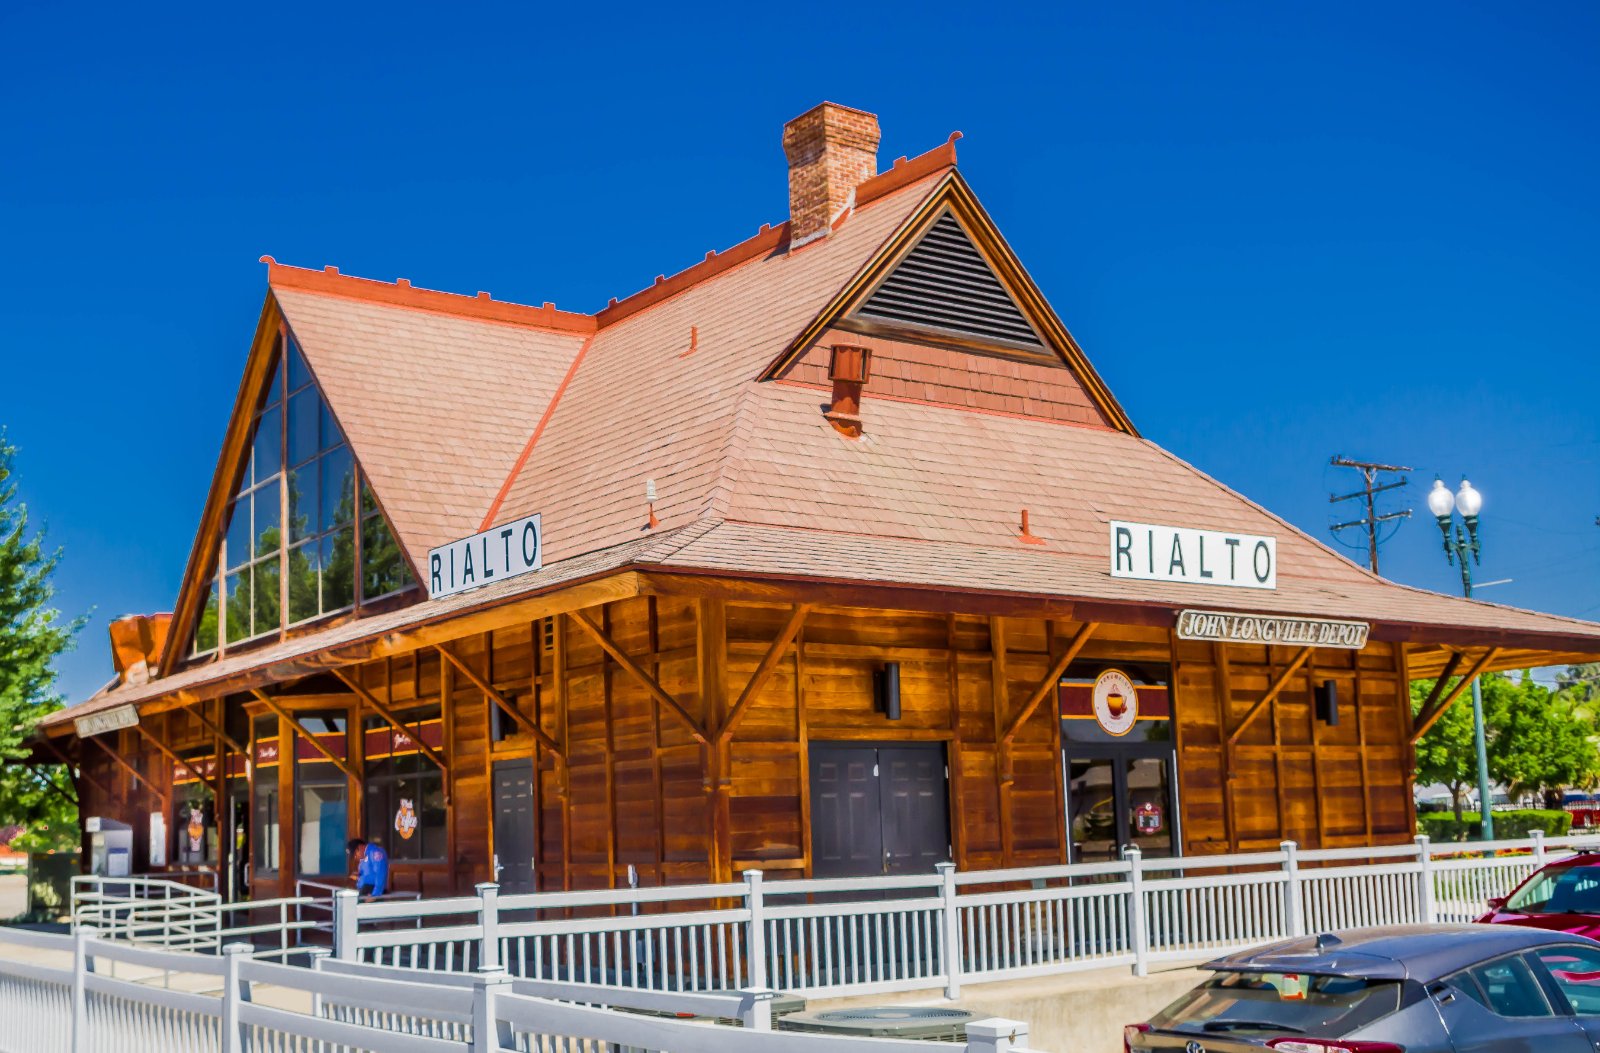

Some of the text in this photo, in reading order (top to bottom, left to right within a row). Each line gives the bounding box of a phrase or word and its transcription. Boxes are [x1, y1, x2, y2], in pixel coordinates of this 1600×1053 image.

[431, 521, 537, 594] RIALTO
[1116, 526, 1270, 583] RIALTO
[1184, 613, 1366, 646] JOHN LONGVILLE DEPOT
